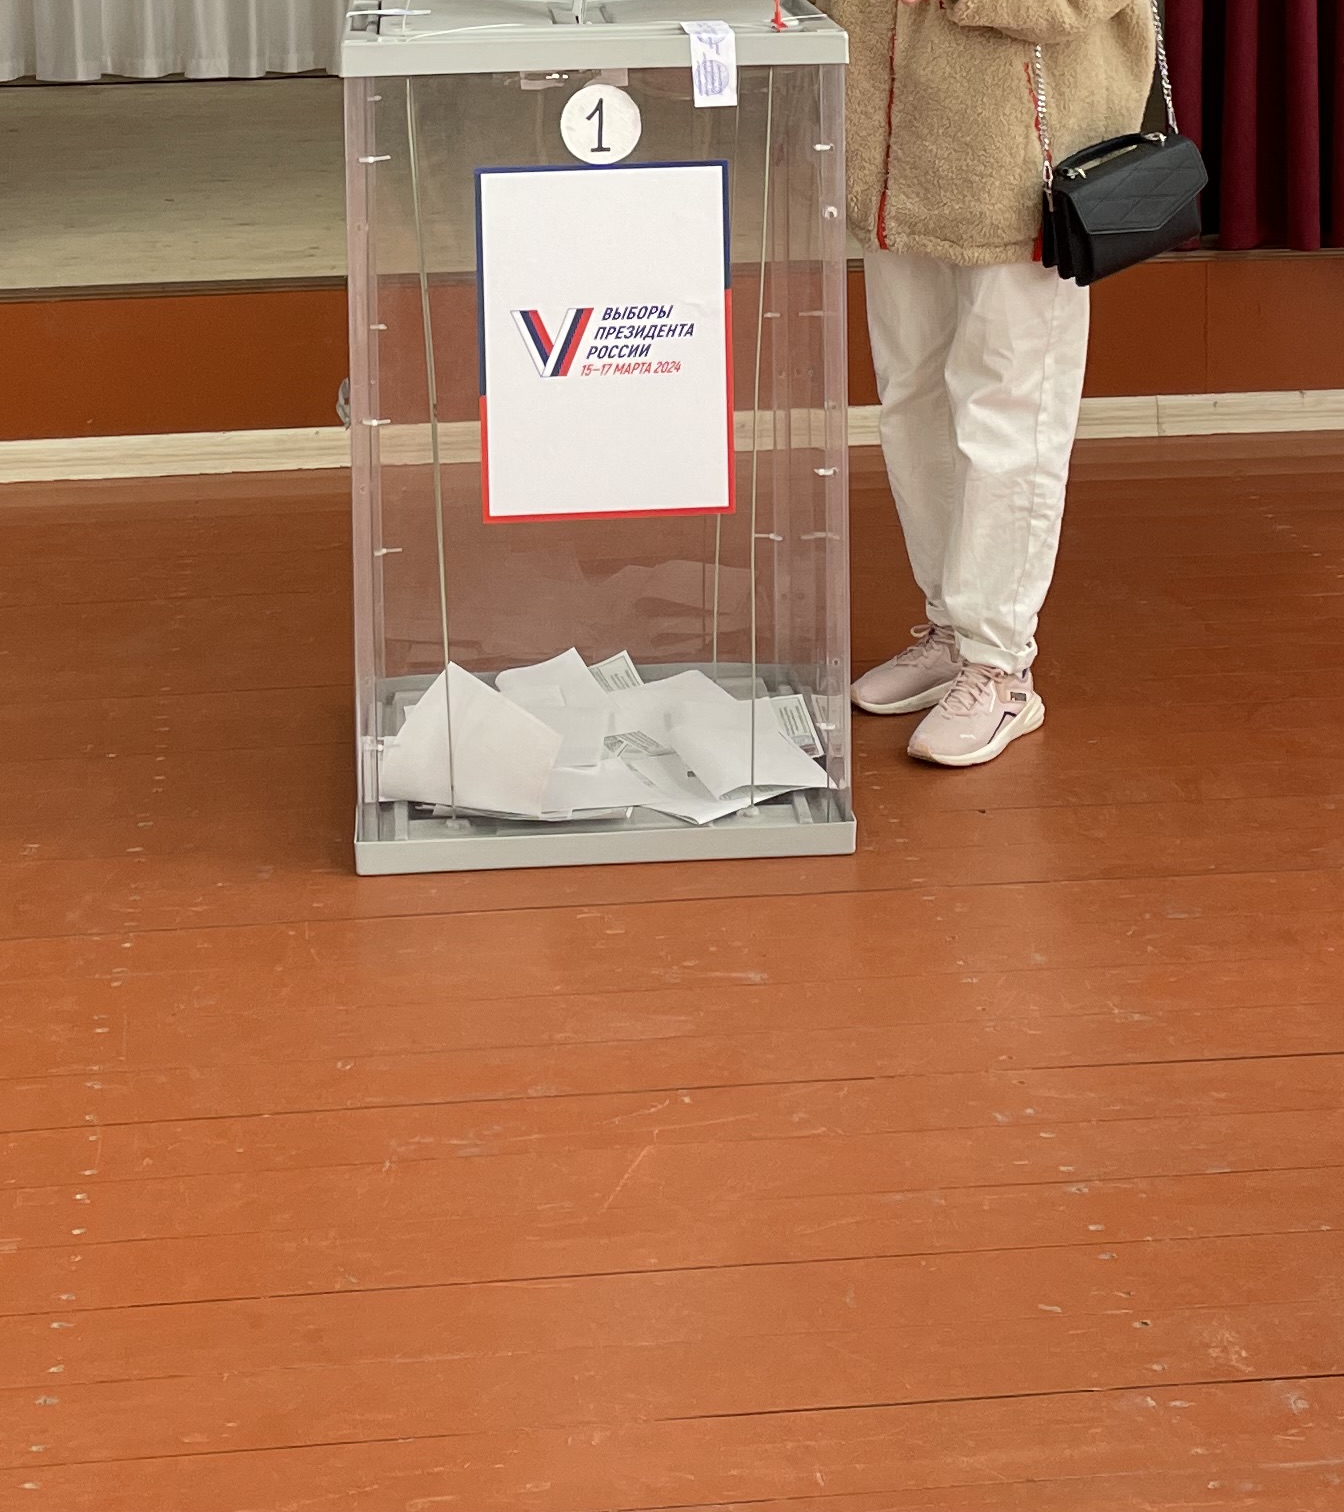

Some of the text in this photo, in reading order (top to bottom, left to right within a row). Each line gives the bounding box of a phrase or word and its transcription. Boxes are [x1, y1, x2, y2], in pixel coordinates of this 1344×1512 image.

[586, 97, 611, 153] 1
[601, 304, 674, 321] ВЫБОРЫ
[593, 322, 695, 341] ПРЕЗИДЕНТА
[585, 343, 652, 360] РОССИИ
[613, 361, 653, 375] МАРТА
[653, 360, 682, 374] 2024
